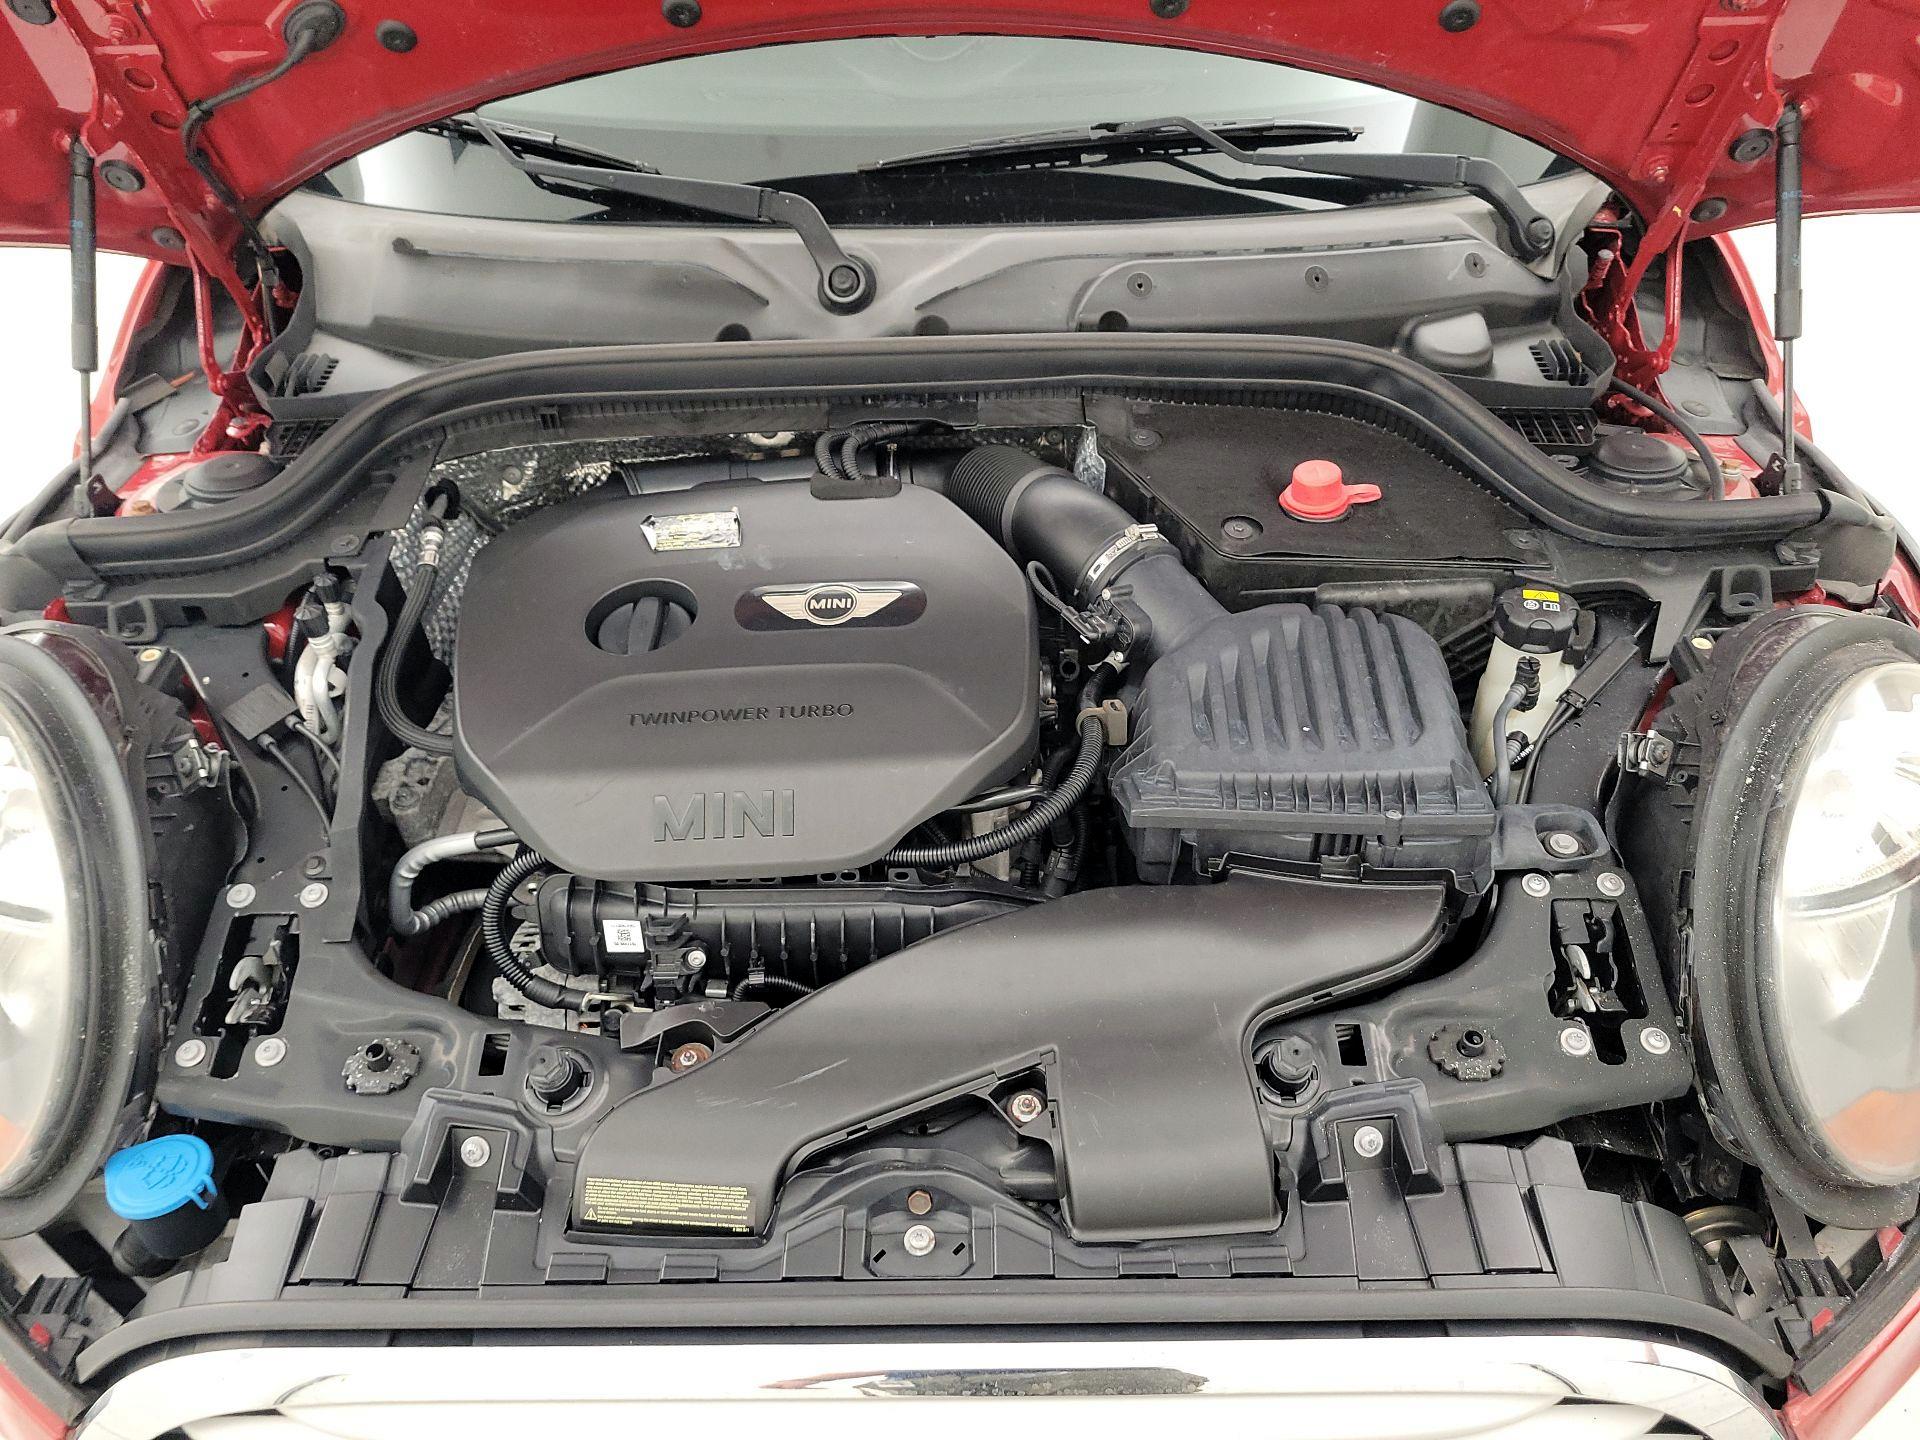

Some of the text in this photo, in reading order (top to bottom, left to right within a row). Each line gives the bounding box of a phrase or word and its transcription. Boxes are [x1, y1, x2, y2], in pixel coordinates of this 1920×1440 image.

[810, 598, 852, 610] MINI
[628, 703, 855, 727] TWINPOWER TURBO
[653, 788, 795, 842] MINI
